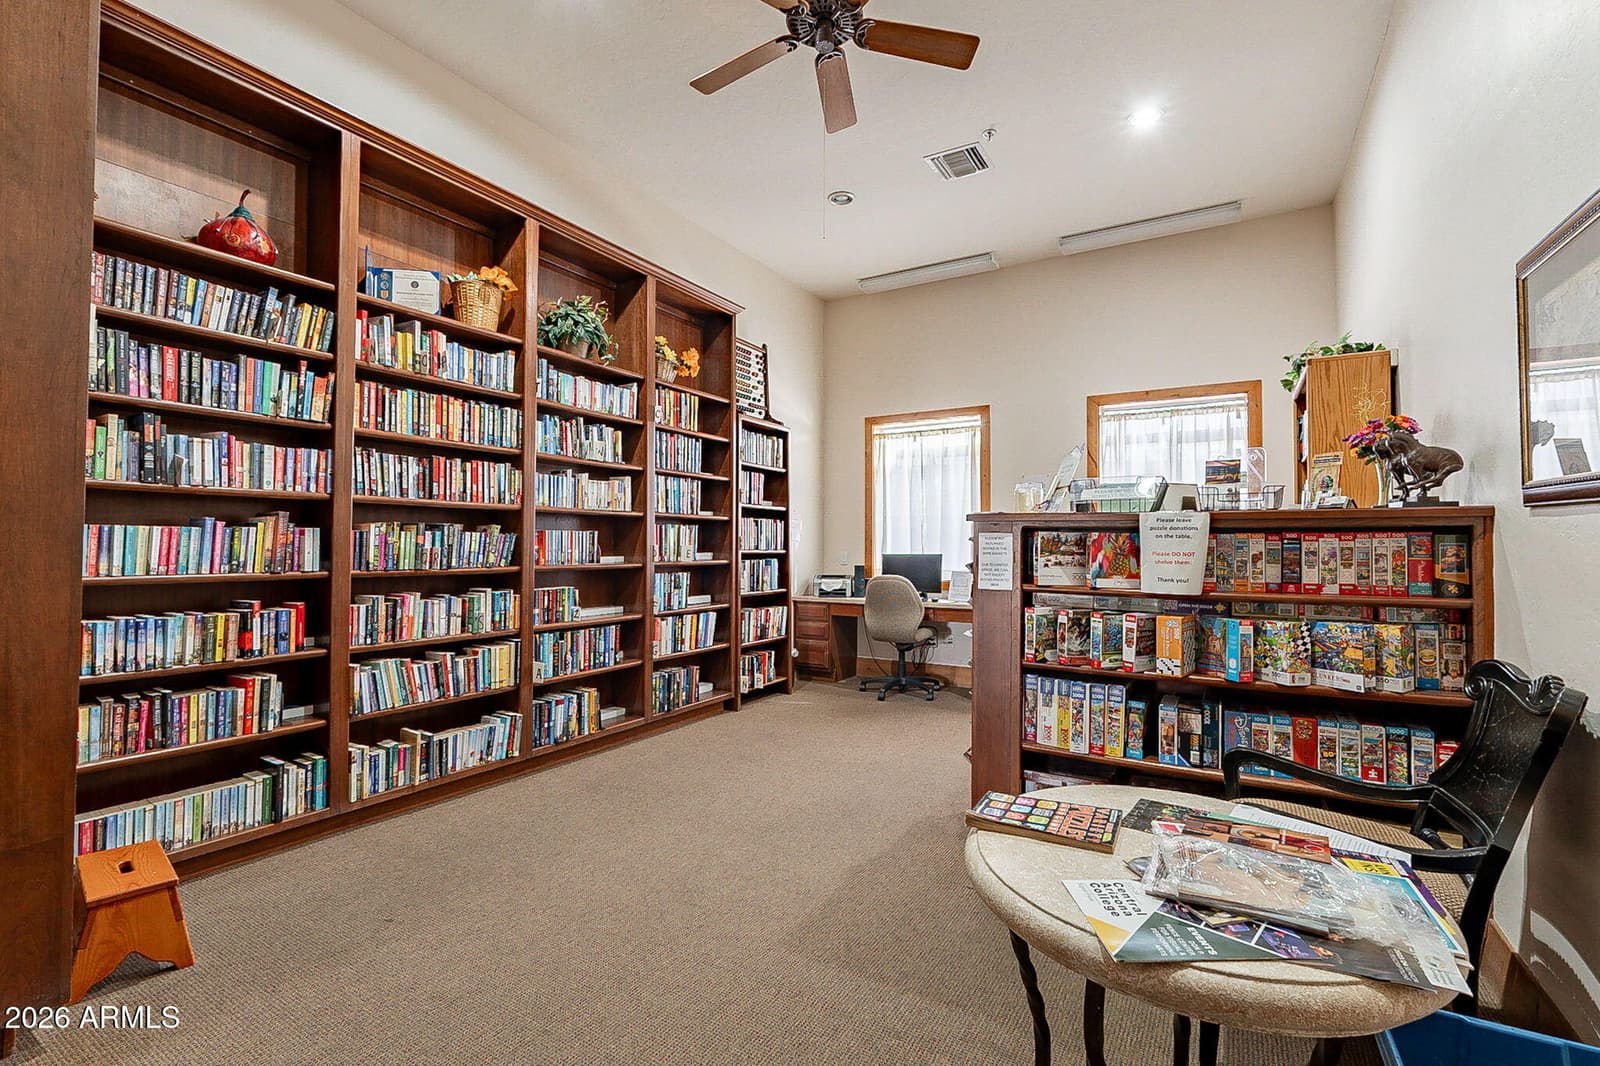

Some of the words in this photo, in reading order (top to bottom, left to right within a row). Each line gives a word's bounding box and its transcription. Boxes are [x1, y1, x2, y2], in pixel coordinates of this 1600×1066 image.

[535, 668, 543, 680] A
[1090, 882, 1120, 917] College
[1100, 882, 1132, 917] Arizona
[1113, 882, 1147, 916] Central
[1186, 927, 1218, 956] EVENTS
